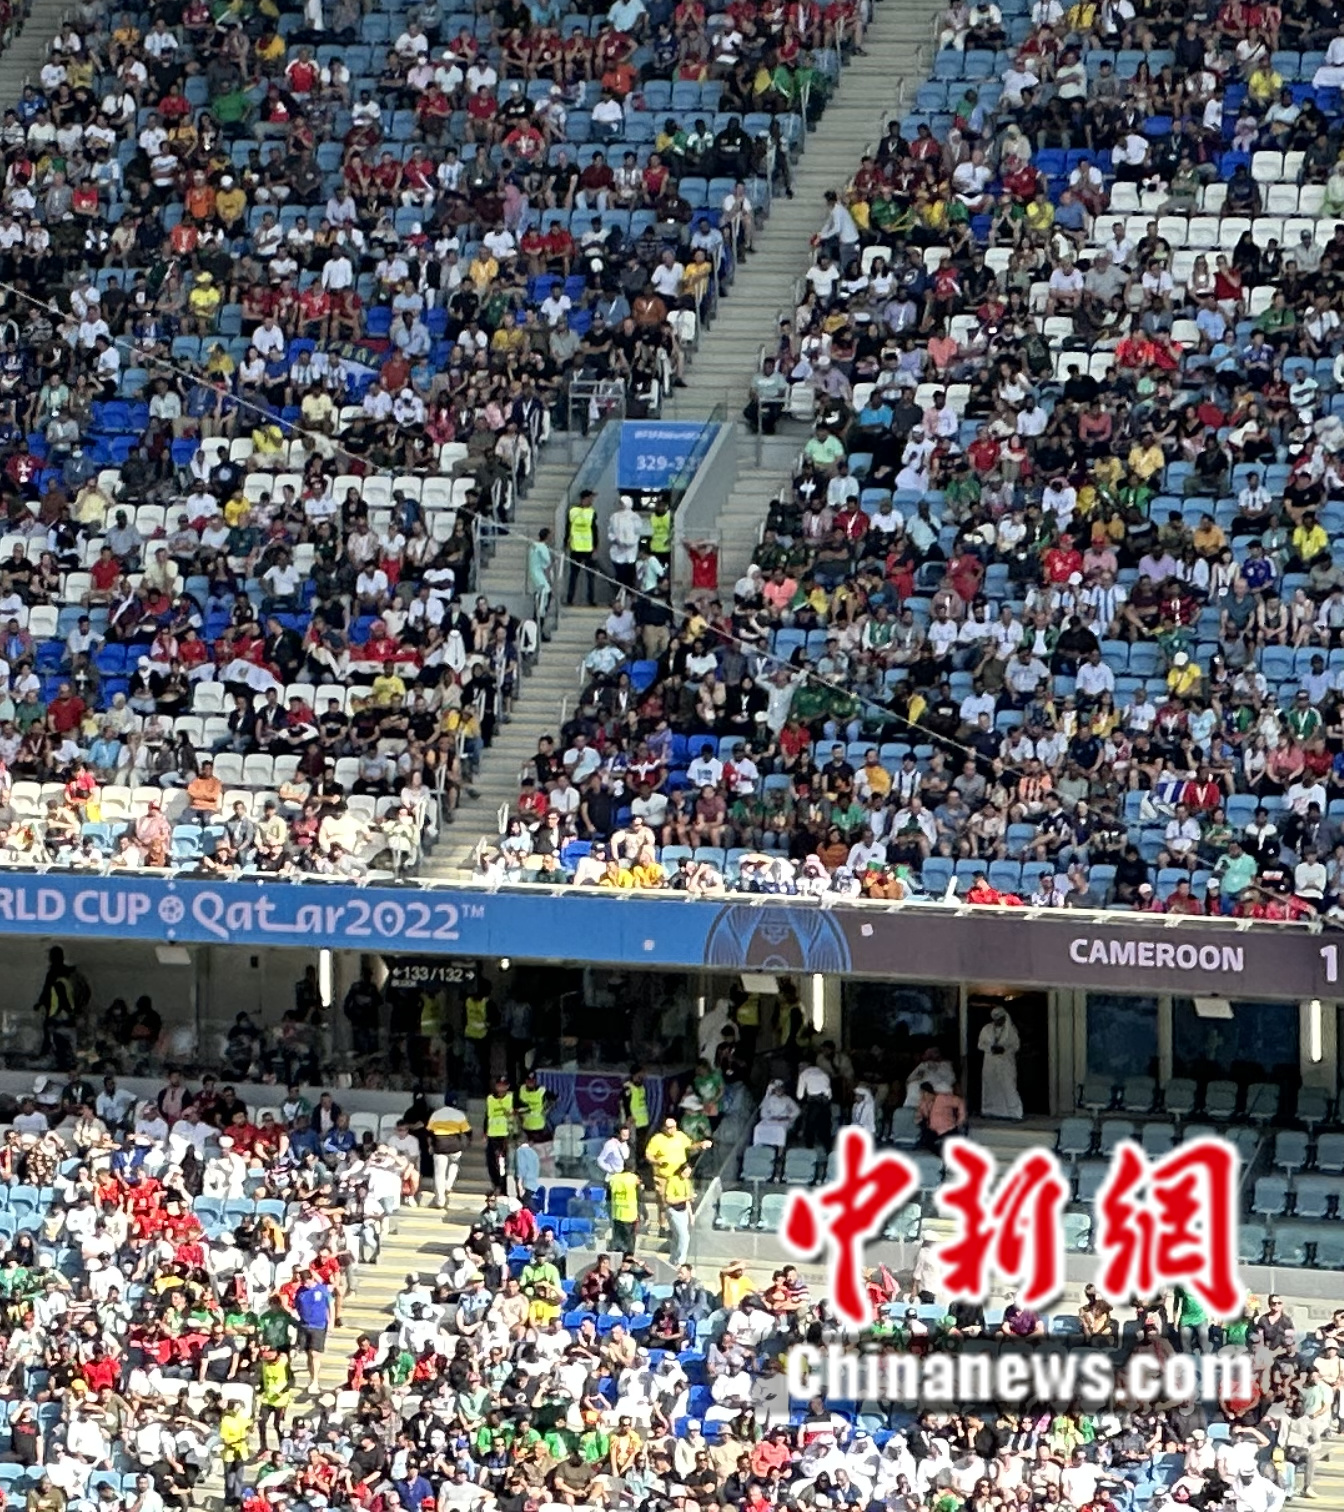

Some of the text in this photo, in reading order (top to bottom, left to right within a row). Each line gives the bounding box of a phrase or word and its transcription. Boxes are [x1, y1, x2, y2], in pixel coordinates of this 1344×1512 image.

[72, 889, 152, 926] CUP
[1068, 938, 1245, 973] CAMEROON
[1319, 944, 1339, 983] 1
